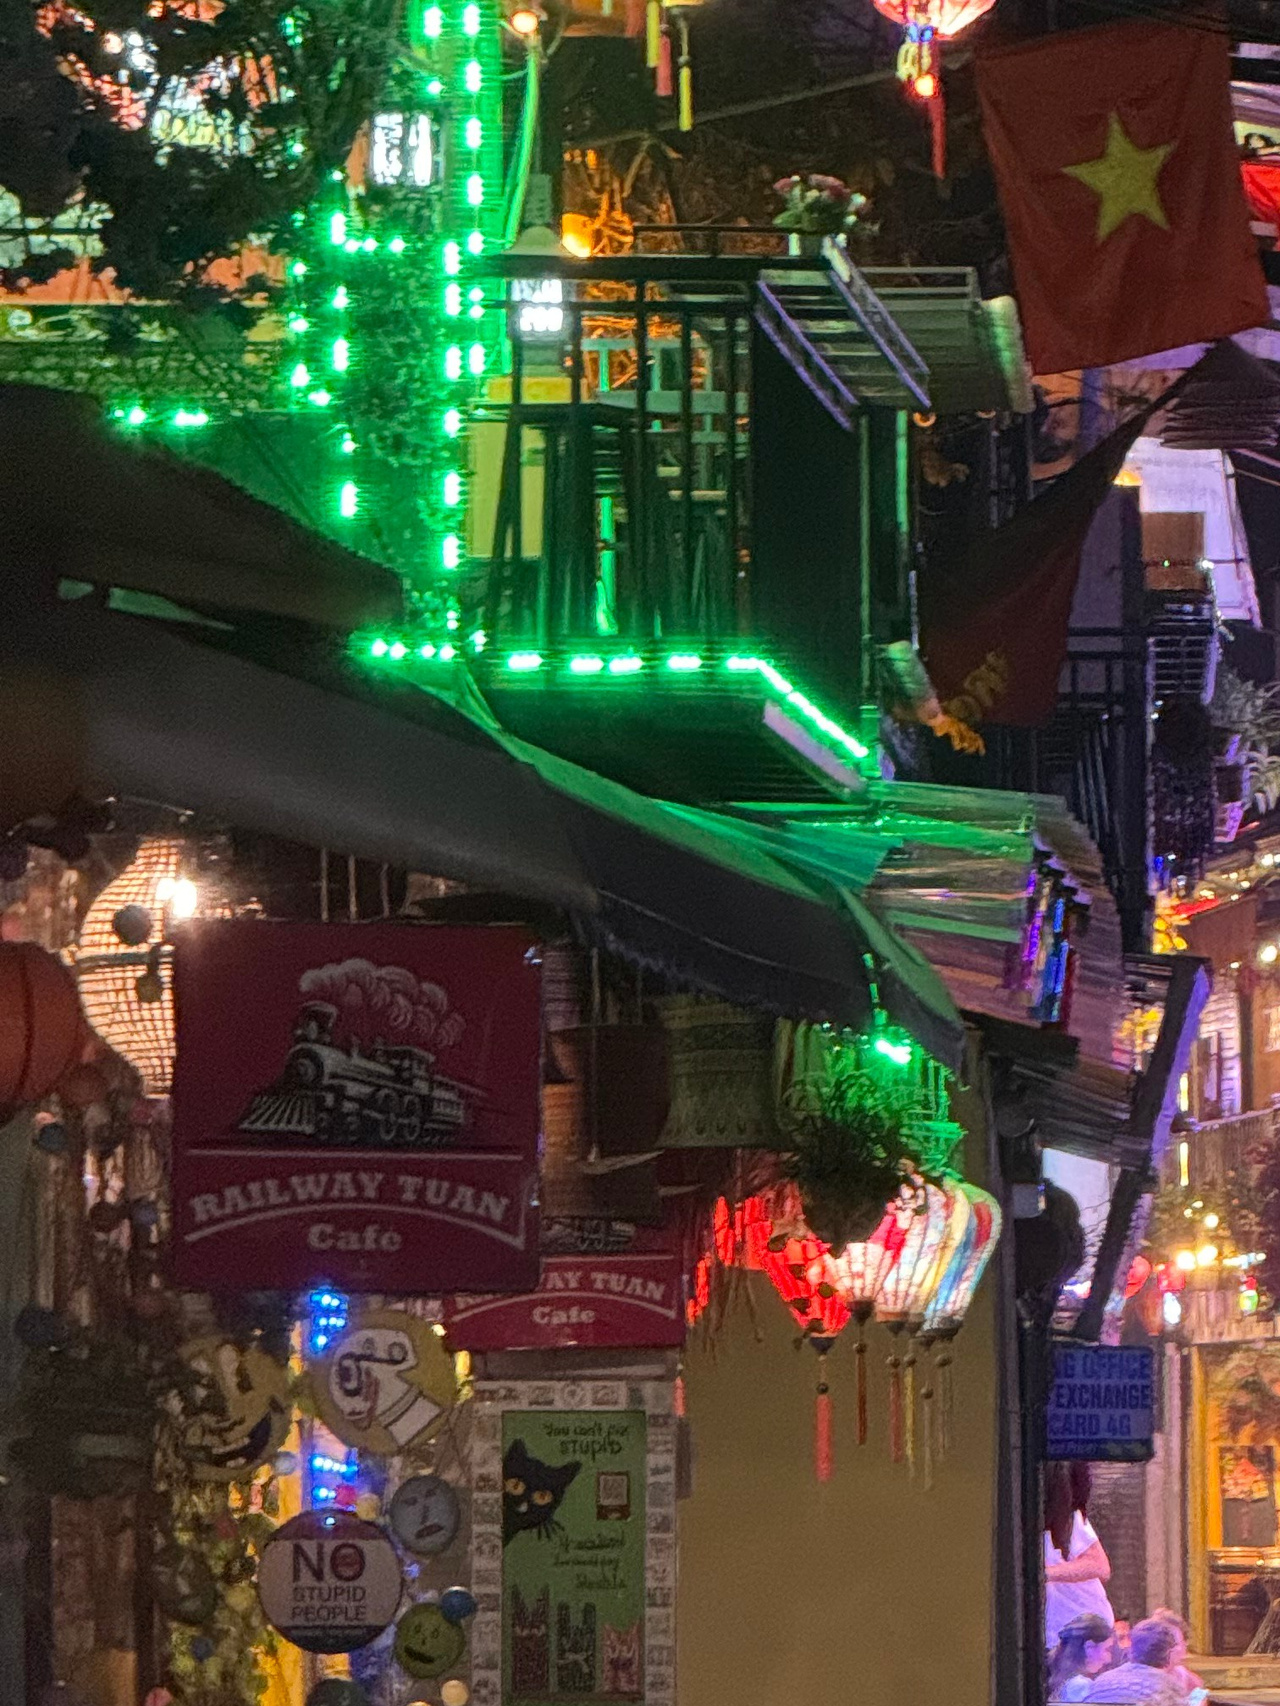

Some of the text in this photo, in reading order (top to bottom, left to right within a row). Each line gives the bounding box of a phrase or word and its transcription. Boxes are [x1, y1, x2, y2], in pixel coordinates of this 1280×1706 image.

[188, 1170, 510, 1224] RAILWAY TUAN
[306, 1222, 403, 1251] Cafe
[590, 1271, 666, 1301] TUAN
[532, 1305, 596, 1325] Cafe
[1082, 1353, 1152, 1380] OFFICE
[1055, 1384, 1151, 1409] EXCHANGE
[1108, 1413, 1132, 1437] 4G
[292, 1542, 366, 1582] NO
[292, 1585, 367, 1603] STUPID
[291, 1604, 367, 1622] PEOPLE
